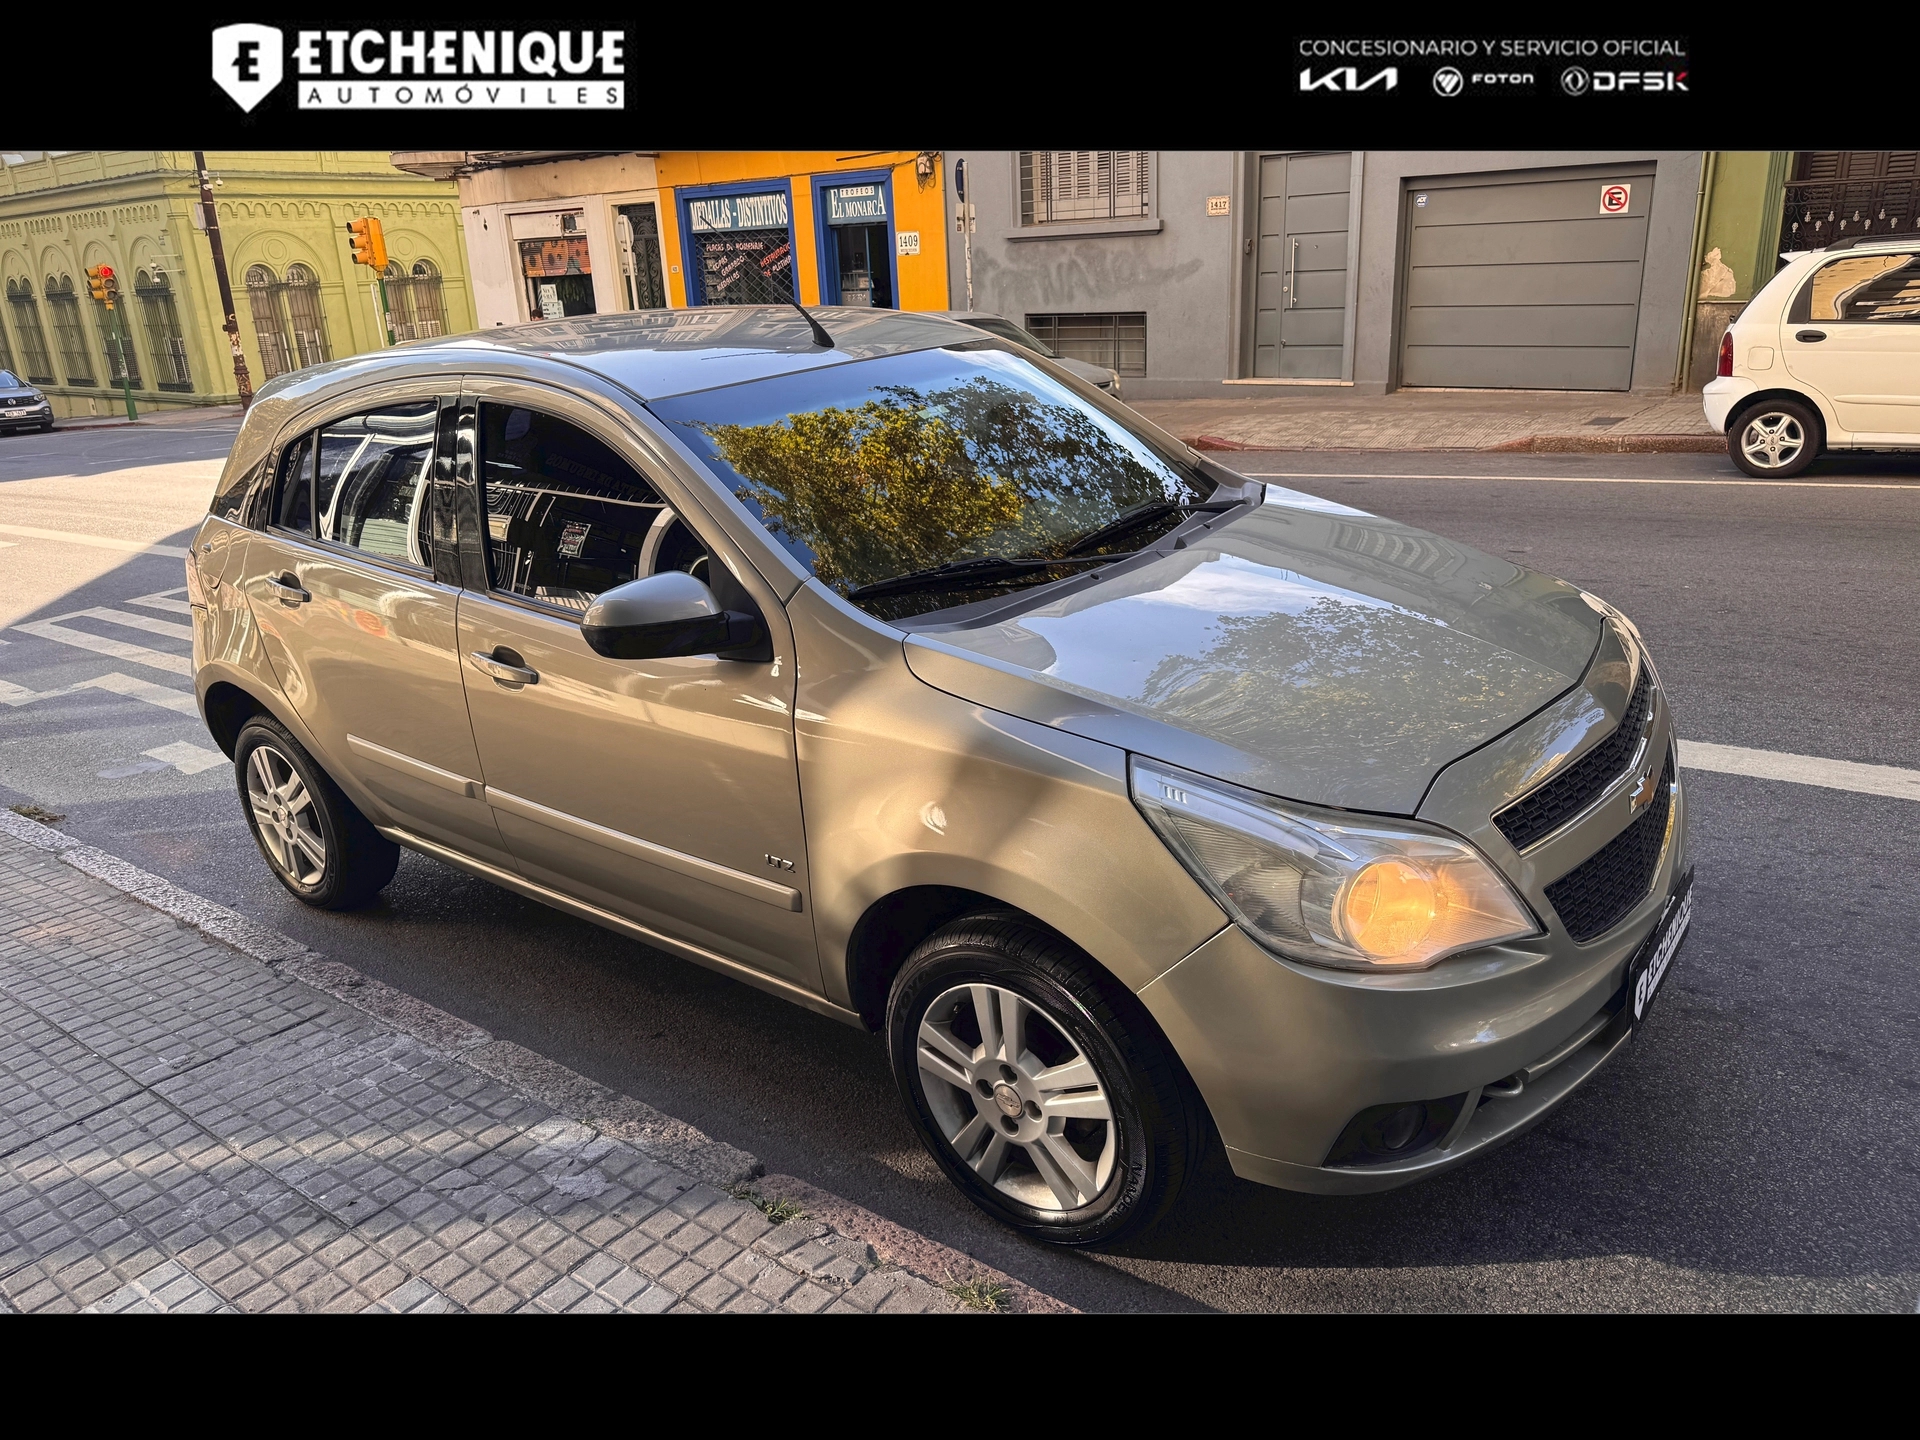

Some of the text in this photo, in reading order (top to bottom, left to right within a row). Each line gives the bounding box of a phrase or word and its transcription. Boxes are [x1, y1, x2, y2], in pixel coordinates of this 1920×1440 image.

[840, 187, 875, 197] TROFEOS
[830, 185, 887, 219] EL MONARCA
[1210, 200, 1227, 208] 1417
[689, 198, 732, 231] MEDALLAS
[736, 193, 789, 228] DISTINTIVOS
[899, 234, 918, 248] 1409
[764, 852, 796, 874] LTZ
